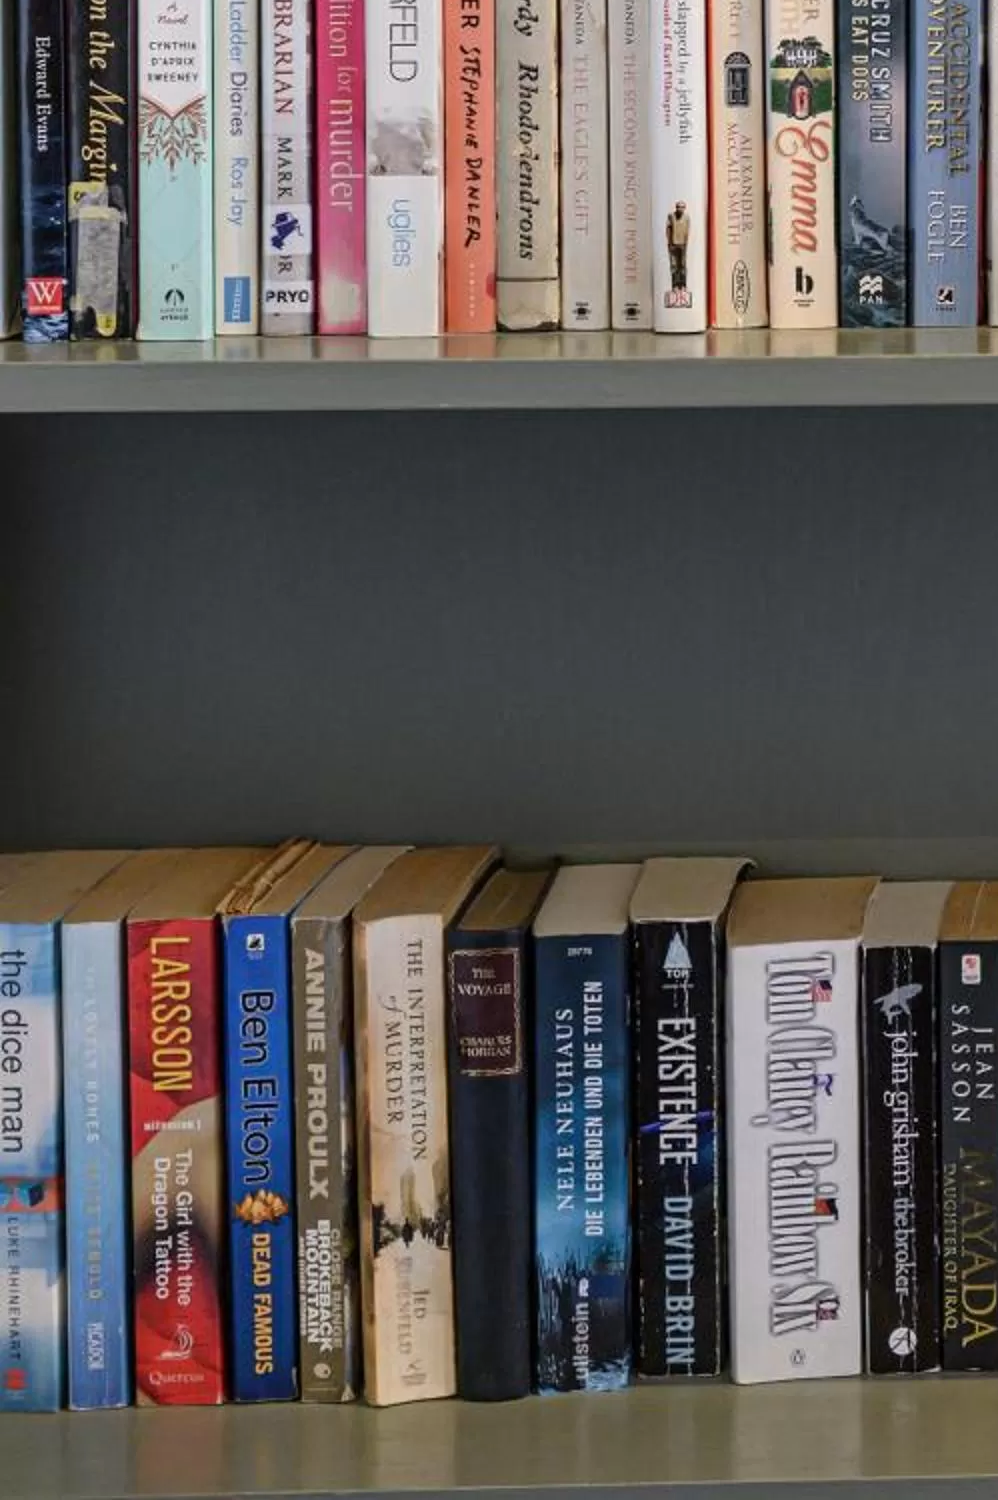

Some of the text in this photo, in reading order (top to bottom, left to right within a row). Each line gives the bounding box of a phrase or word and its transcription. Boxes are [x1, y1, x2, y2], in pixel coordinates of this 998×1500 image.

[88, 30, 117, 69] the
[228, 0, 248, 64] Ladder
[336, 64, 356, 93] for
[850, 16, 868, 48] EAT
[850, 54, 868, 101] DOGS
[35, 36, 52, 153] Edward Evans
[228, 71, 248, 137] Diaries
[871, 66, 893, 144] SMITH
[277, 136, 293, 199] MARK
[329, 99, 364, 212] murder
[516, 61, 541, 260] Rhododendrons
[775, 122, 829, 254] Emma
[386, 199, 418, 268] uglies
[1, 949, 28, 1154] the dice man
[150, 937, 193, 1092] LARSSON
[950, 1004, 972, 1123] SASSON
[973, 1026, 994, 1100] JEAN
[240, 990, 279, 1184] Ben Elton
[303, 948, 330, 1200] ANNIE PROULX
[883, 1029, 919, 1186] john grisham
[152, 1156, 174, 1300] Dragon Tattoo
[175, 1147, 196, 1307] The Girl with the
[657, 1017, 697, 1365] EXISTENCE DAVID BRIN
[253, 1232, 274, 1375] DEAD FAMOUS
